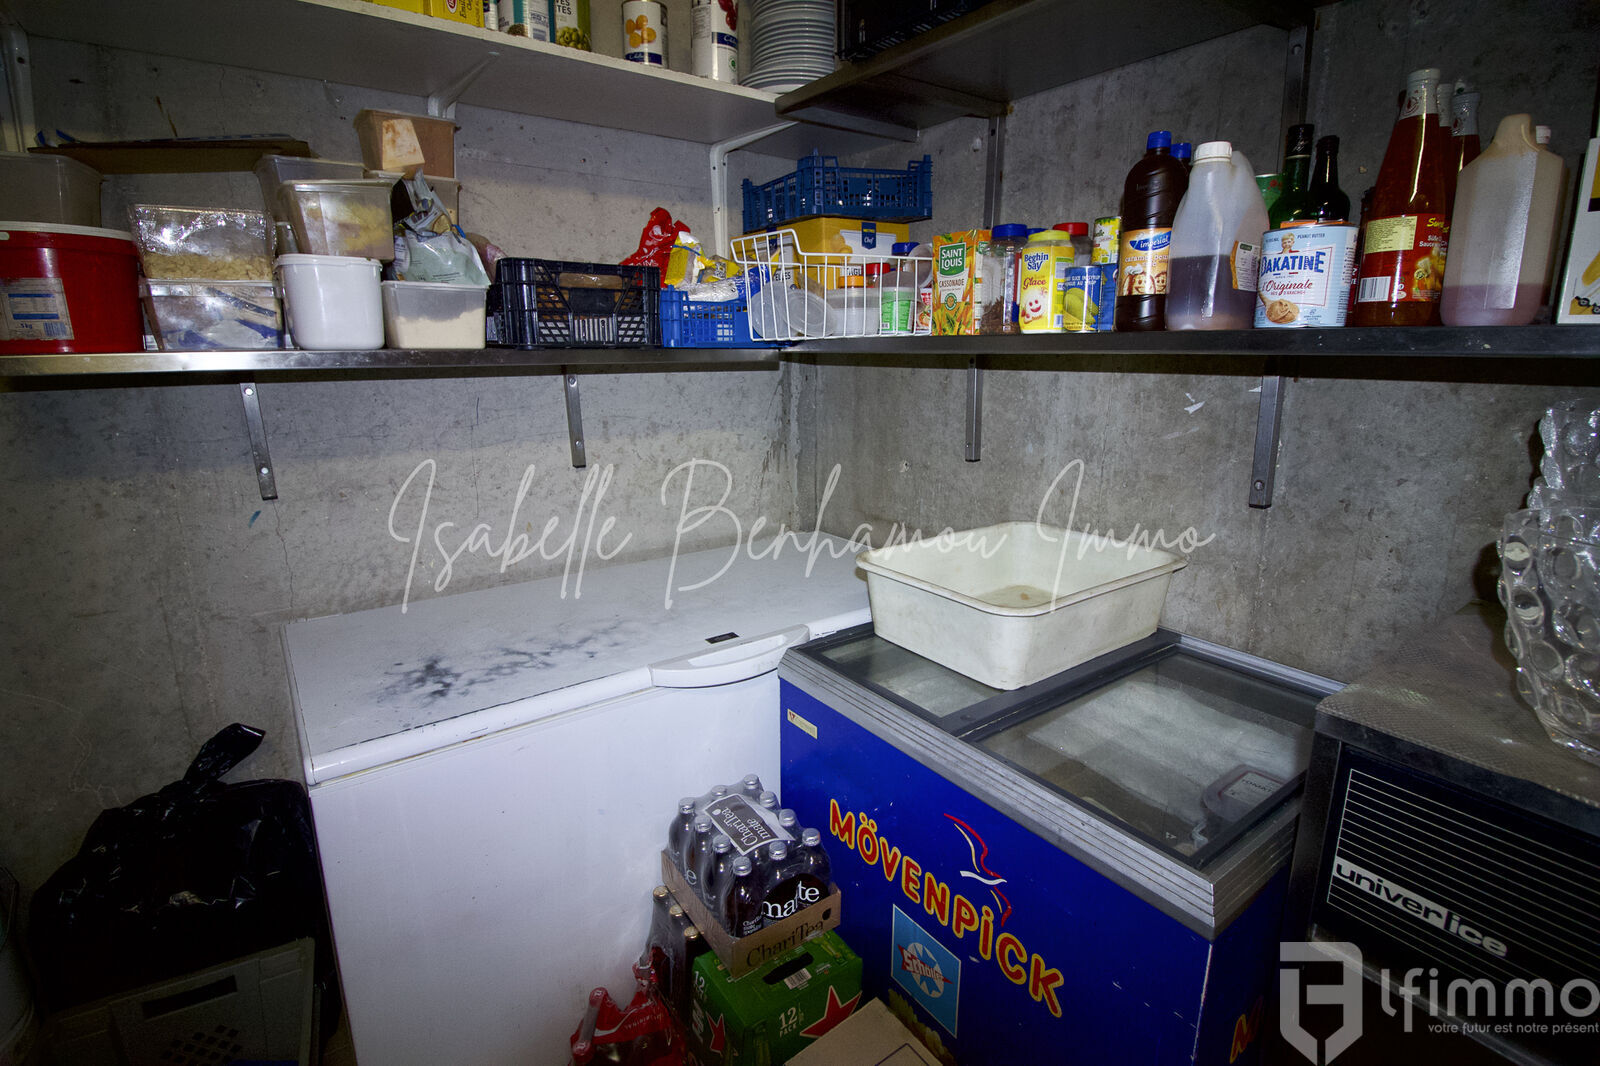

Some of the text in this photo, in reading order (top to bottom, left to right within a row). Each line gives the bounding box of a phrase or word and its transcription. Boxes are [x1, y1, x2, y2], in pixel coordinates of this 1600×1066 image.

[941, 248, 964, 259] SAINT
[1024, 252, 1049, 264] Beghin
[941, 257, 963, 271] LOUIS
[1027, 260, 1043, 272] Say
[1260, 250, 1326, 277] DAKATINE
[938, 278, 965, 288] CASSONADE
[1023, 276, 1047, 290] Glace
[830, 798, 1064, 1017] MÖVENPICK
[746, 919, 824, 967] ChariTea
[779, 1006, 798, 1027] 12
